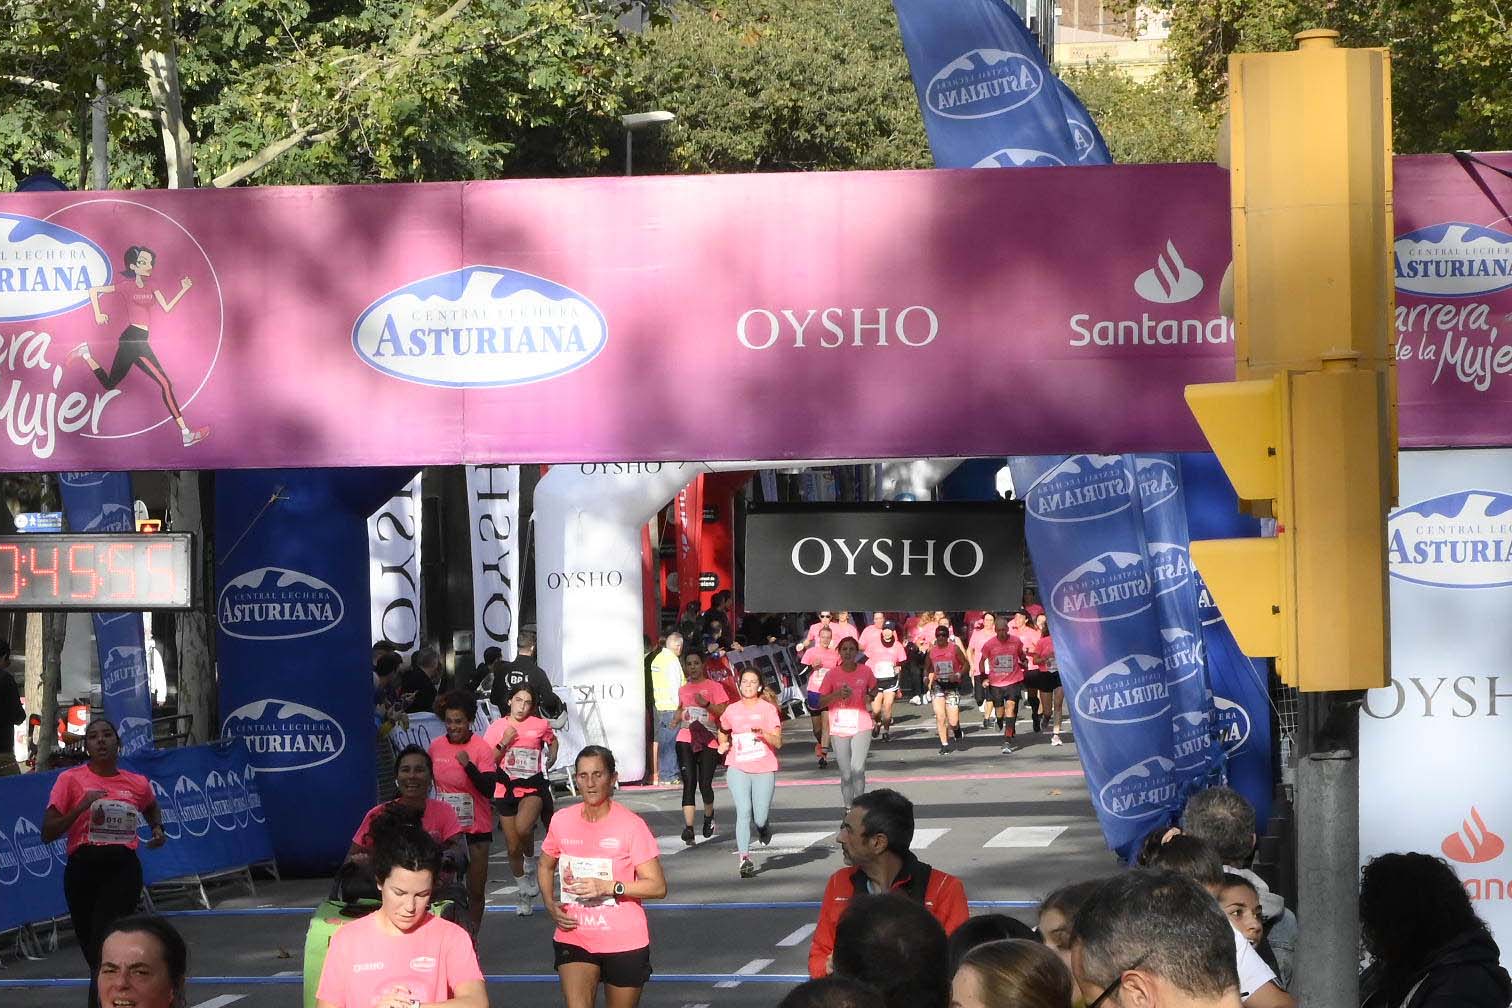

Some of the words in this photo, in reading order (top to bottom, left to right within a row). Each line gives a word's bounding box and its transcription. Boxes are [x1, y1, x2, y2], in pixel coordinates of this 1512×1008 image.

[1395, 252, 1512, 279] ASTURIAN
[736, 305, 939, 349] OYSHO
[1069, 312, 1234, 347] Santand
[1395, 303, 1490, 332] arrera
[372, 313, 588, 358] ASTURIANA
[1418, 333, 1436, 360] la
[1432, 327, 1512, 391] Muje
[1416, 525, 1481, 535] CENTRAL
[791, 537, 984, 578] OYSHO
[547, 570, 623, 590] OYSHO
[222, 597, 335, 624] ASTURIANA
[1361, 675, 1512, 720] OYSH
